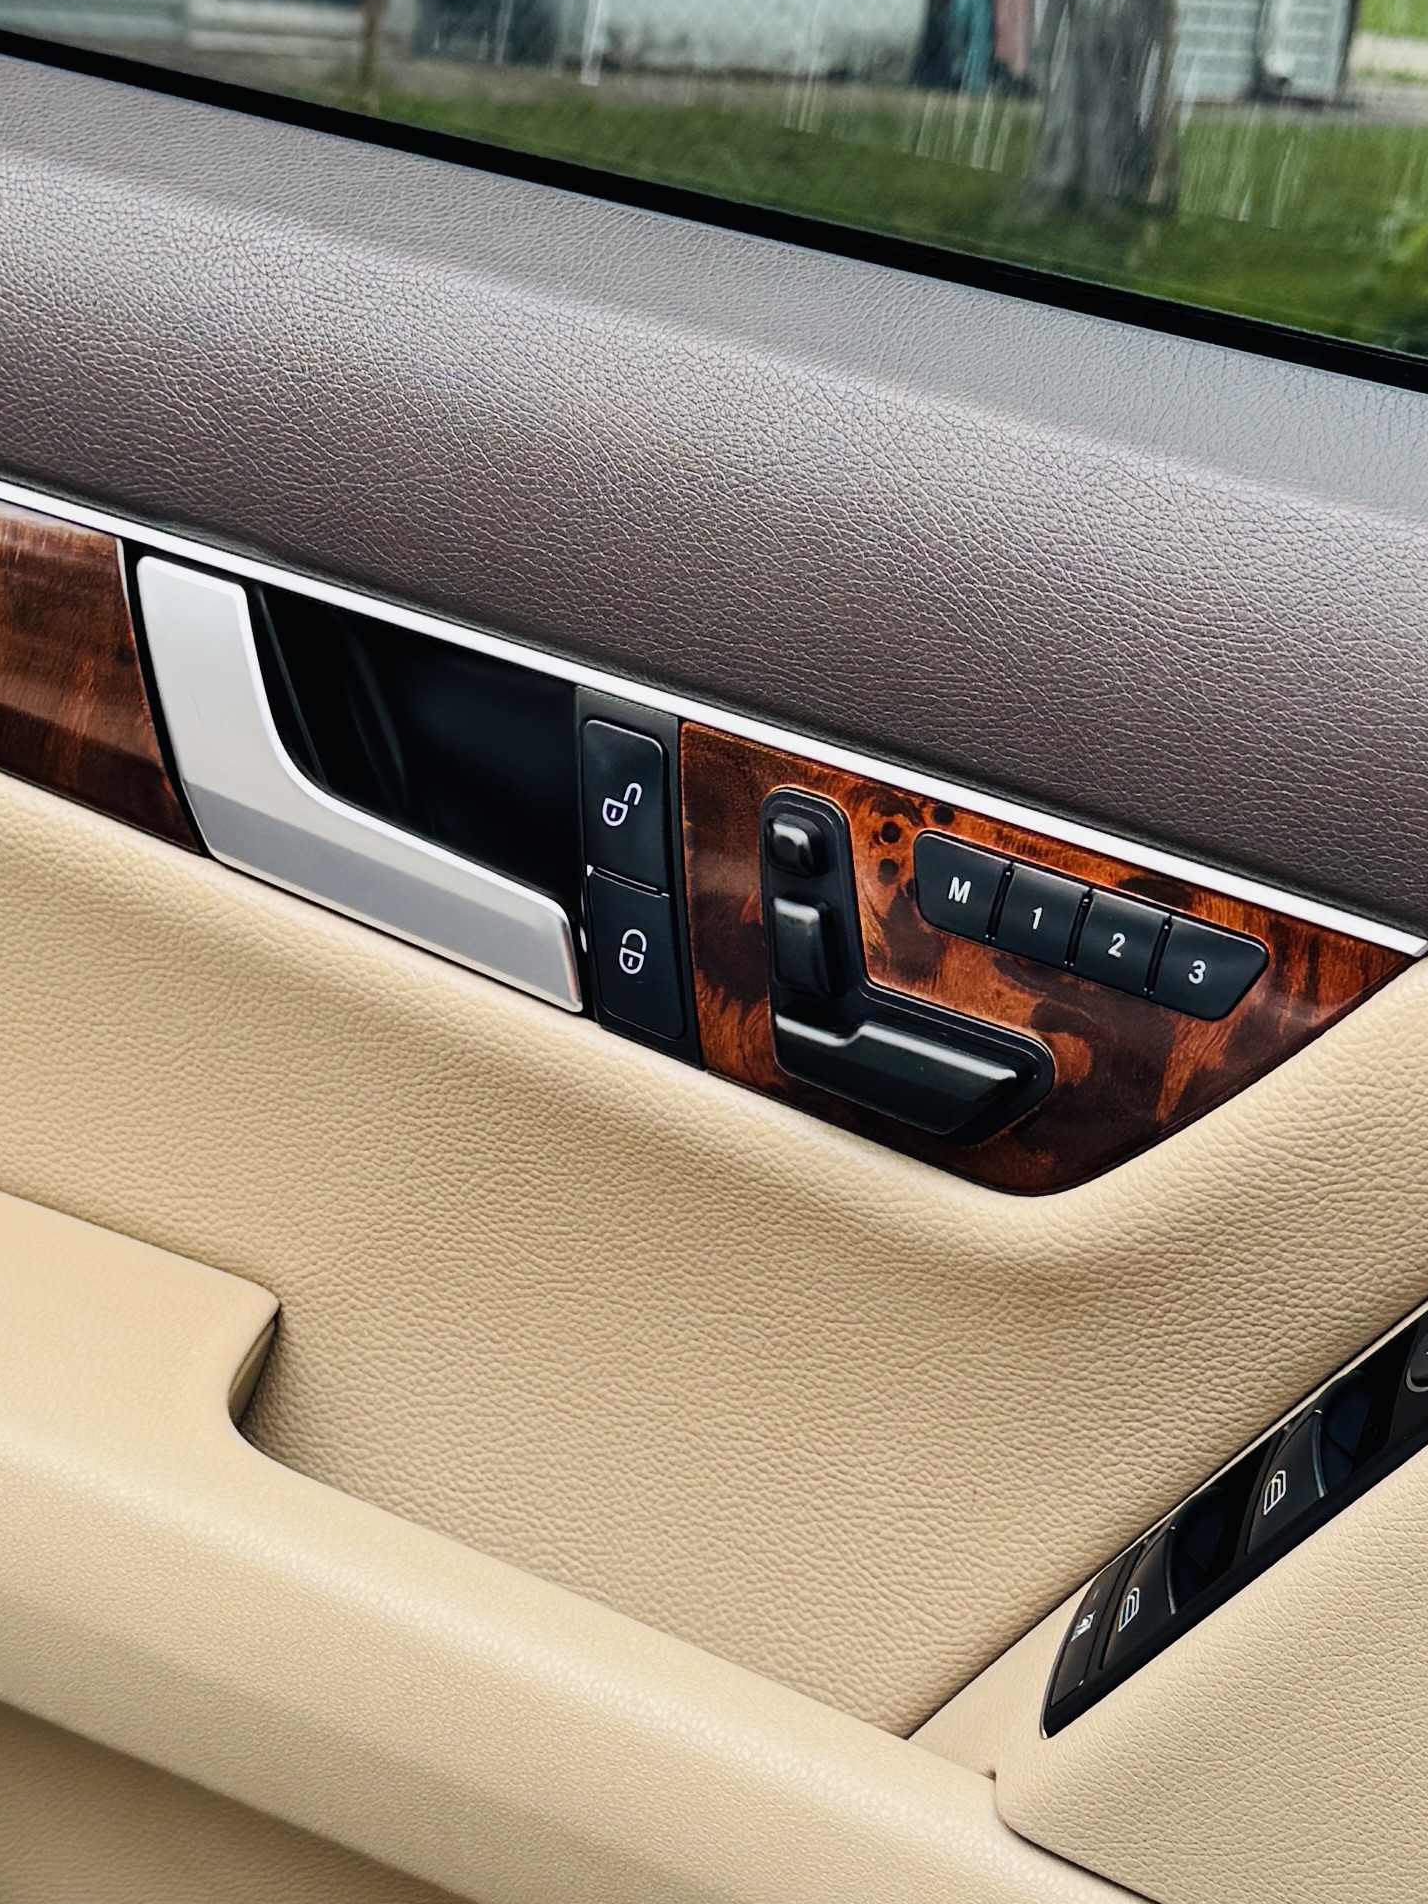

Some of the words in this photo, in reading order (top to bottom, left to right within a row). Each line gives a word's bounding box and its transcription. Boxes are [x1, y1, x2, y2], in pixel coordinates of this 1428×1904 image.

[948, 876, 972, 904] M
[1032, 907, 1043, 930] 1
[1107, 932, 1126, 958] 2
[1188, 959, 1207, 985] 3
